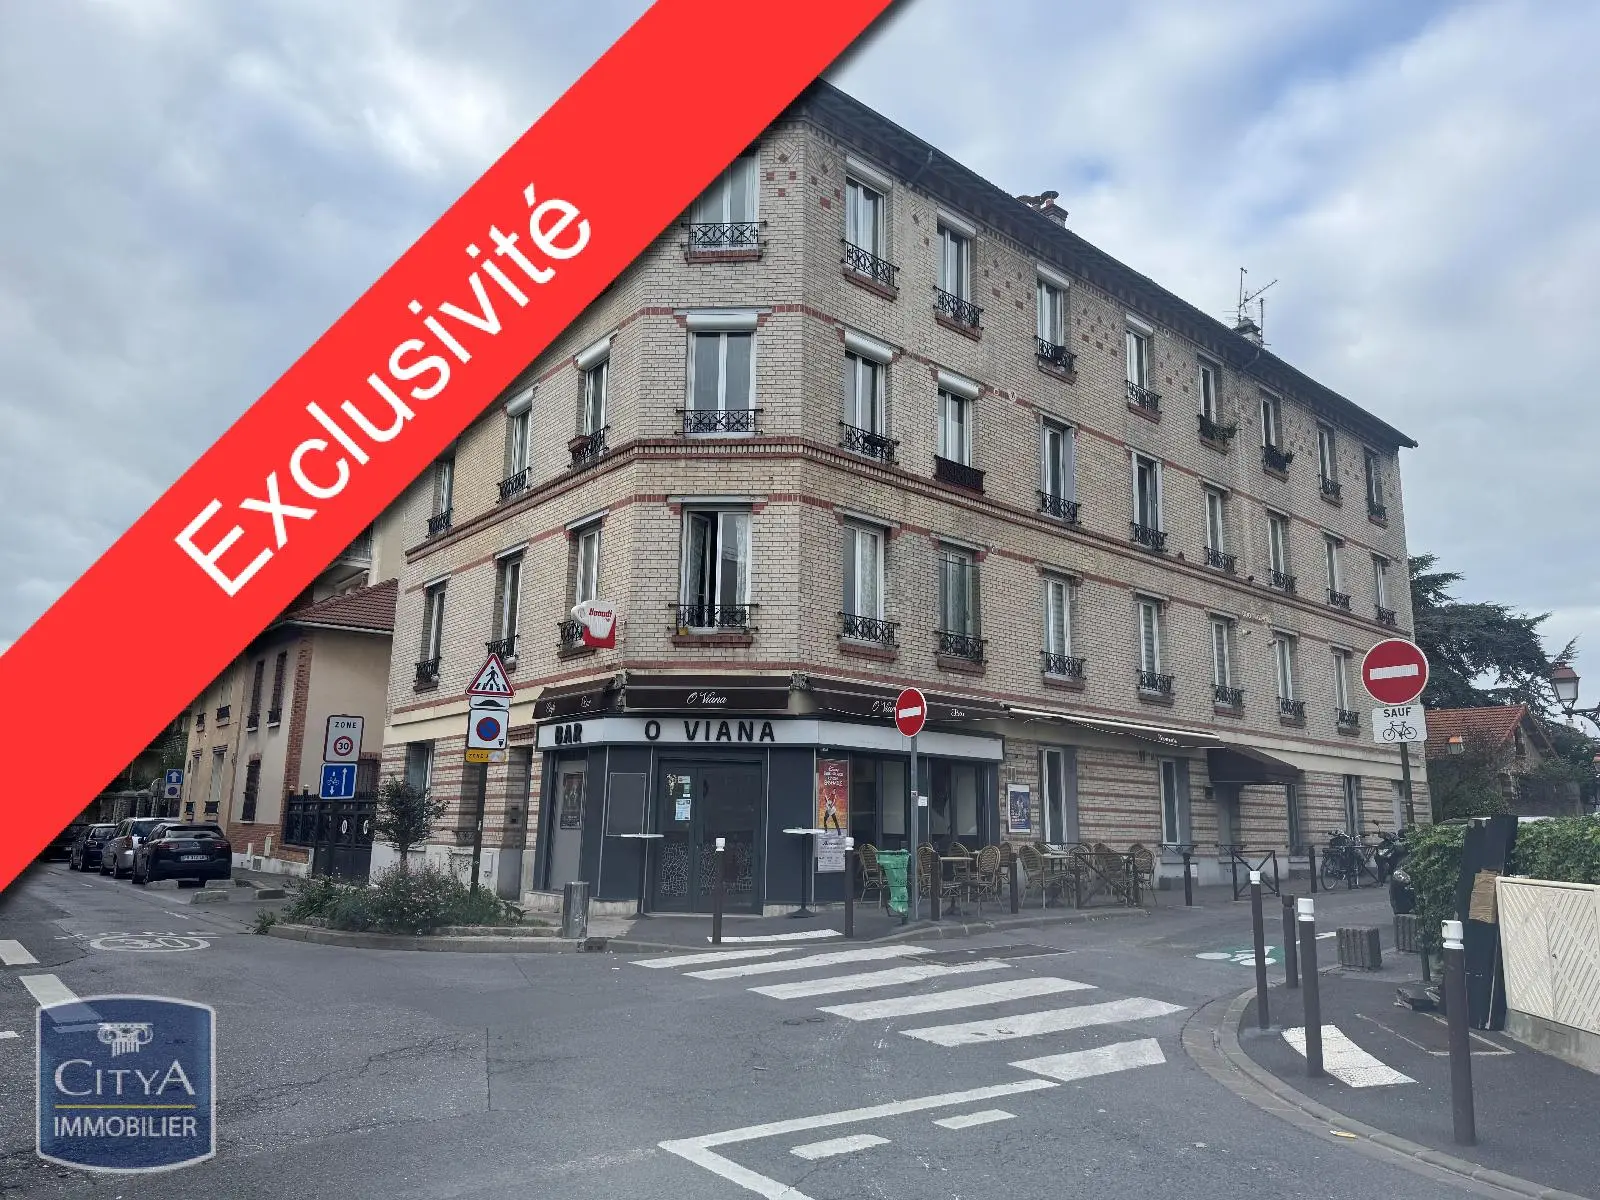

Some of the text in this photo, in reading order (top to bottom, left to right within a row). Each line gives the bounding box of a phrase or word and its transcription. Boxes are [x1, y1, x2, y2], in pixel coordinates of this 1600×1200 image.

[686, 691, 728, 704] O Viana
[1383, 706, 1412, 718] SAUF
[334, 721, 358, 729] ZONE
[644, 719, 776, 742] O VIANA
[554, 722, 583, 745] BAR
[338, 742, 350, 751] 30
